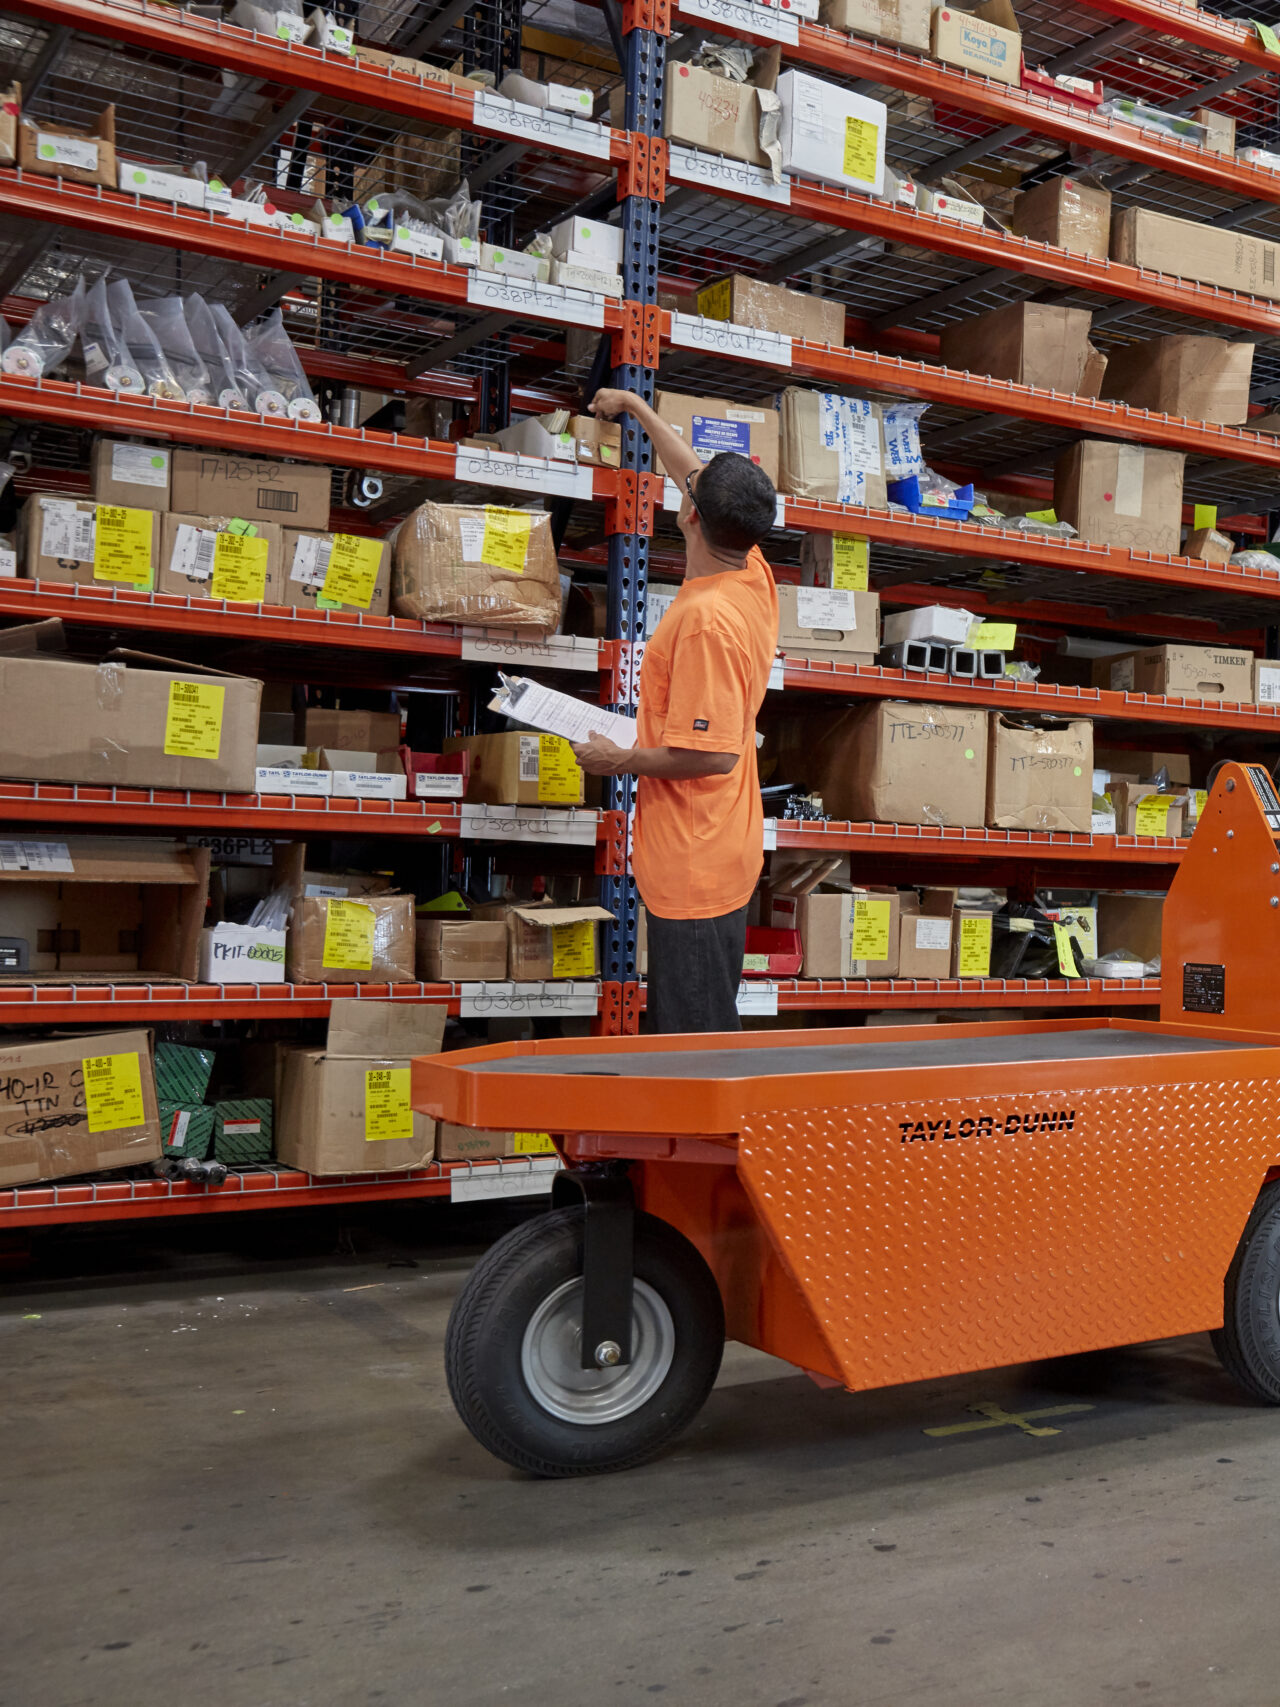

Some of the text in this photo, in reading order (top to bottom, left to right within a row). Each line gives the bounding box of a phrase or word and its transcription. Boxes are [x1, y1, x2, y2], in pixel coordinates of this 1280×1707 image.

[963, 30, 988, 49] Koyo
[200, 458, 284, 483] 17-125-52
[468, 459, 541, 481] 038PE1
[1213, 654, 1247, 667] TIMKEN
[888, 722, 967, 743] TTI-500377
[291, 771, 328, 779] TAYLOR-DUNN
[898, 1110, 1076, 1144] TAYLOR-DUNN
